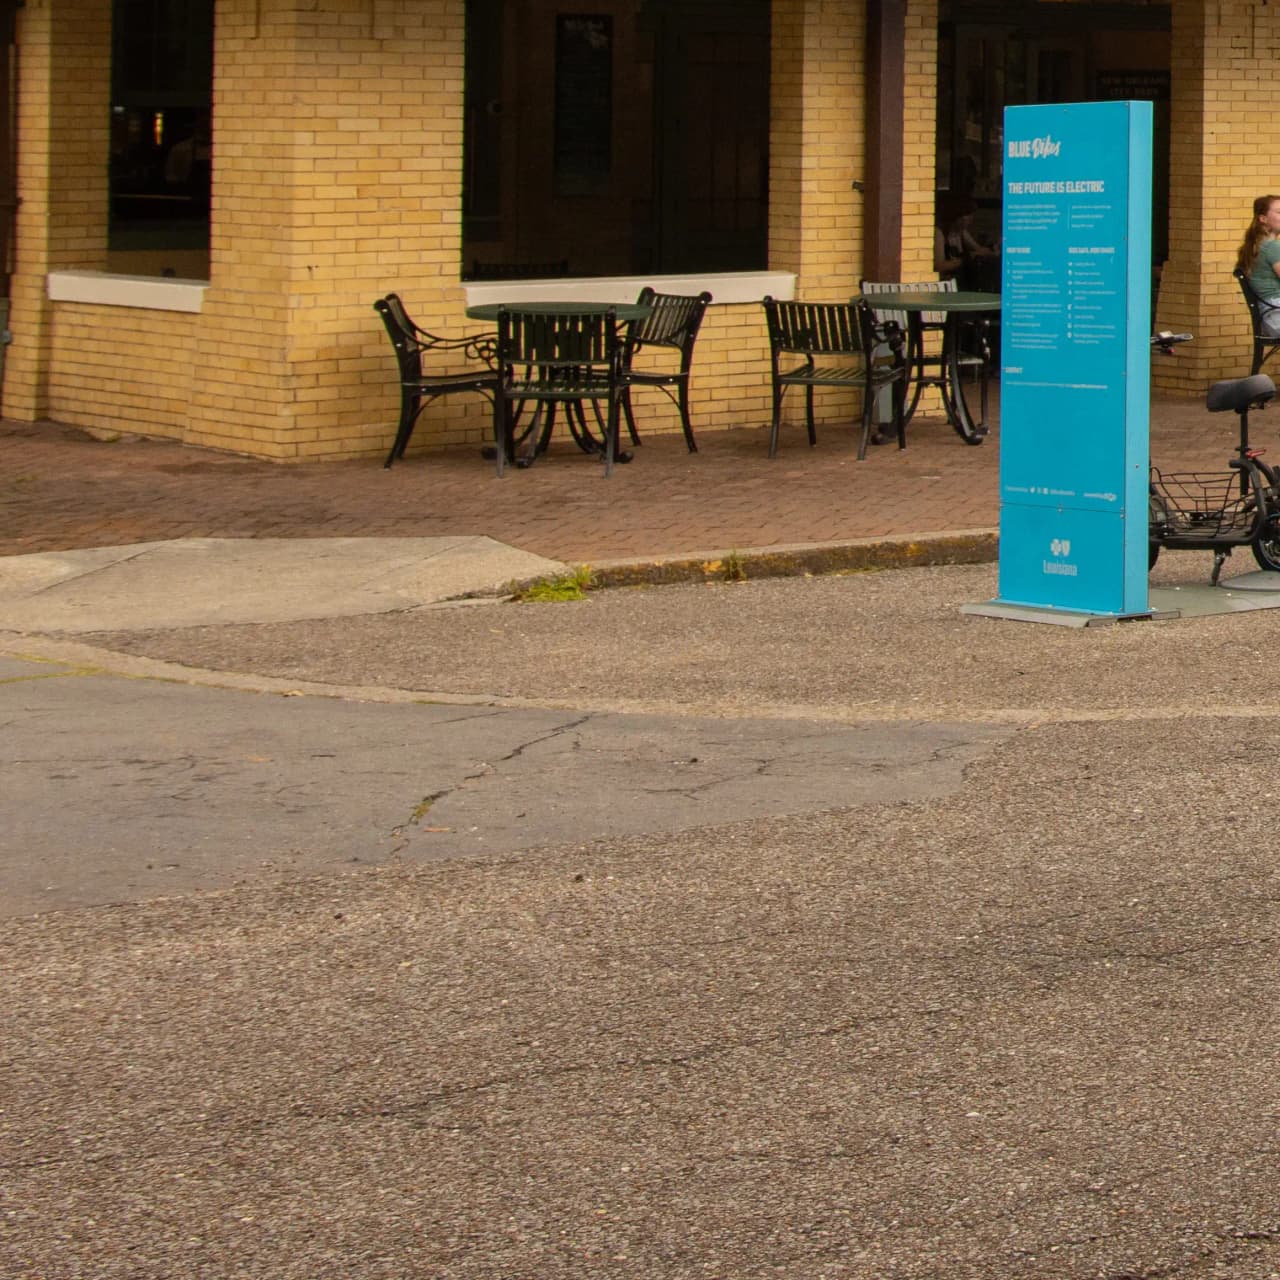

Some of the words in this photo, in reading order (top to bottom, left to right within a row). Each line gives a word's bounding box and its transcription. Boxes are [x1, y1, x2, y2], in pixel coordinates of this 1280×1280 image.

[1008, 141, 1032, 158] BLUE
[1031, 134, 1062, 160] Bikes
[1008, 182, 1023, 194] THE
[1024, 181, 1055, 194] FUTURE
[1057, 181, 1065, 193] IS
[1066, 180, 1105, 193] ELECTRIC
[1043, 559, 1078, 577] Louisiana
